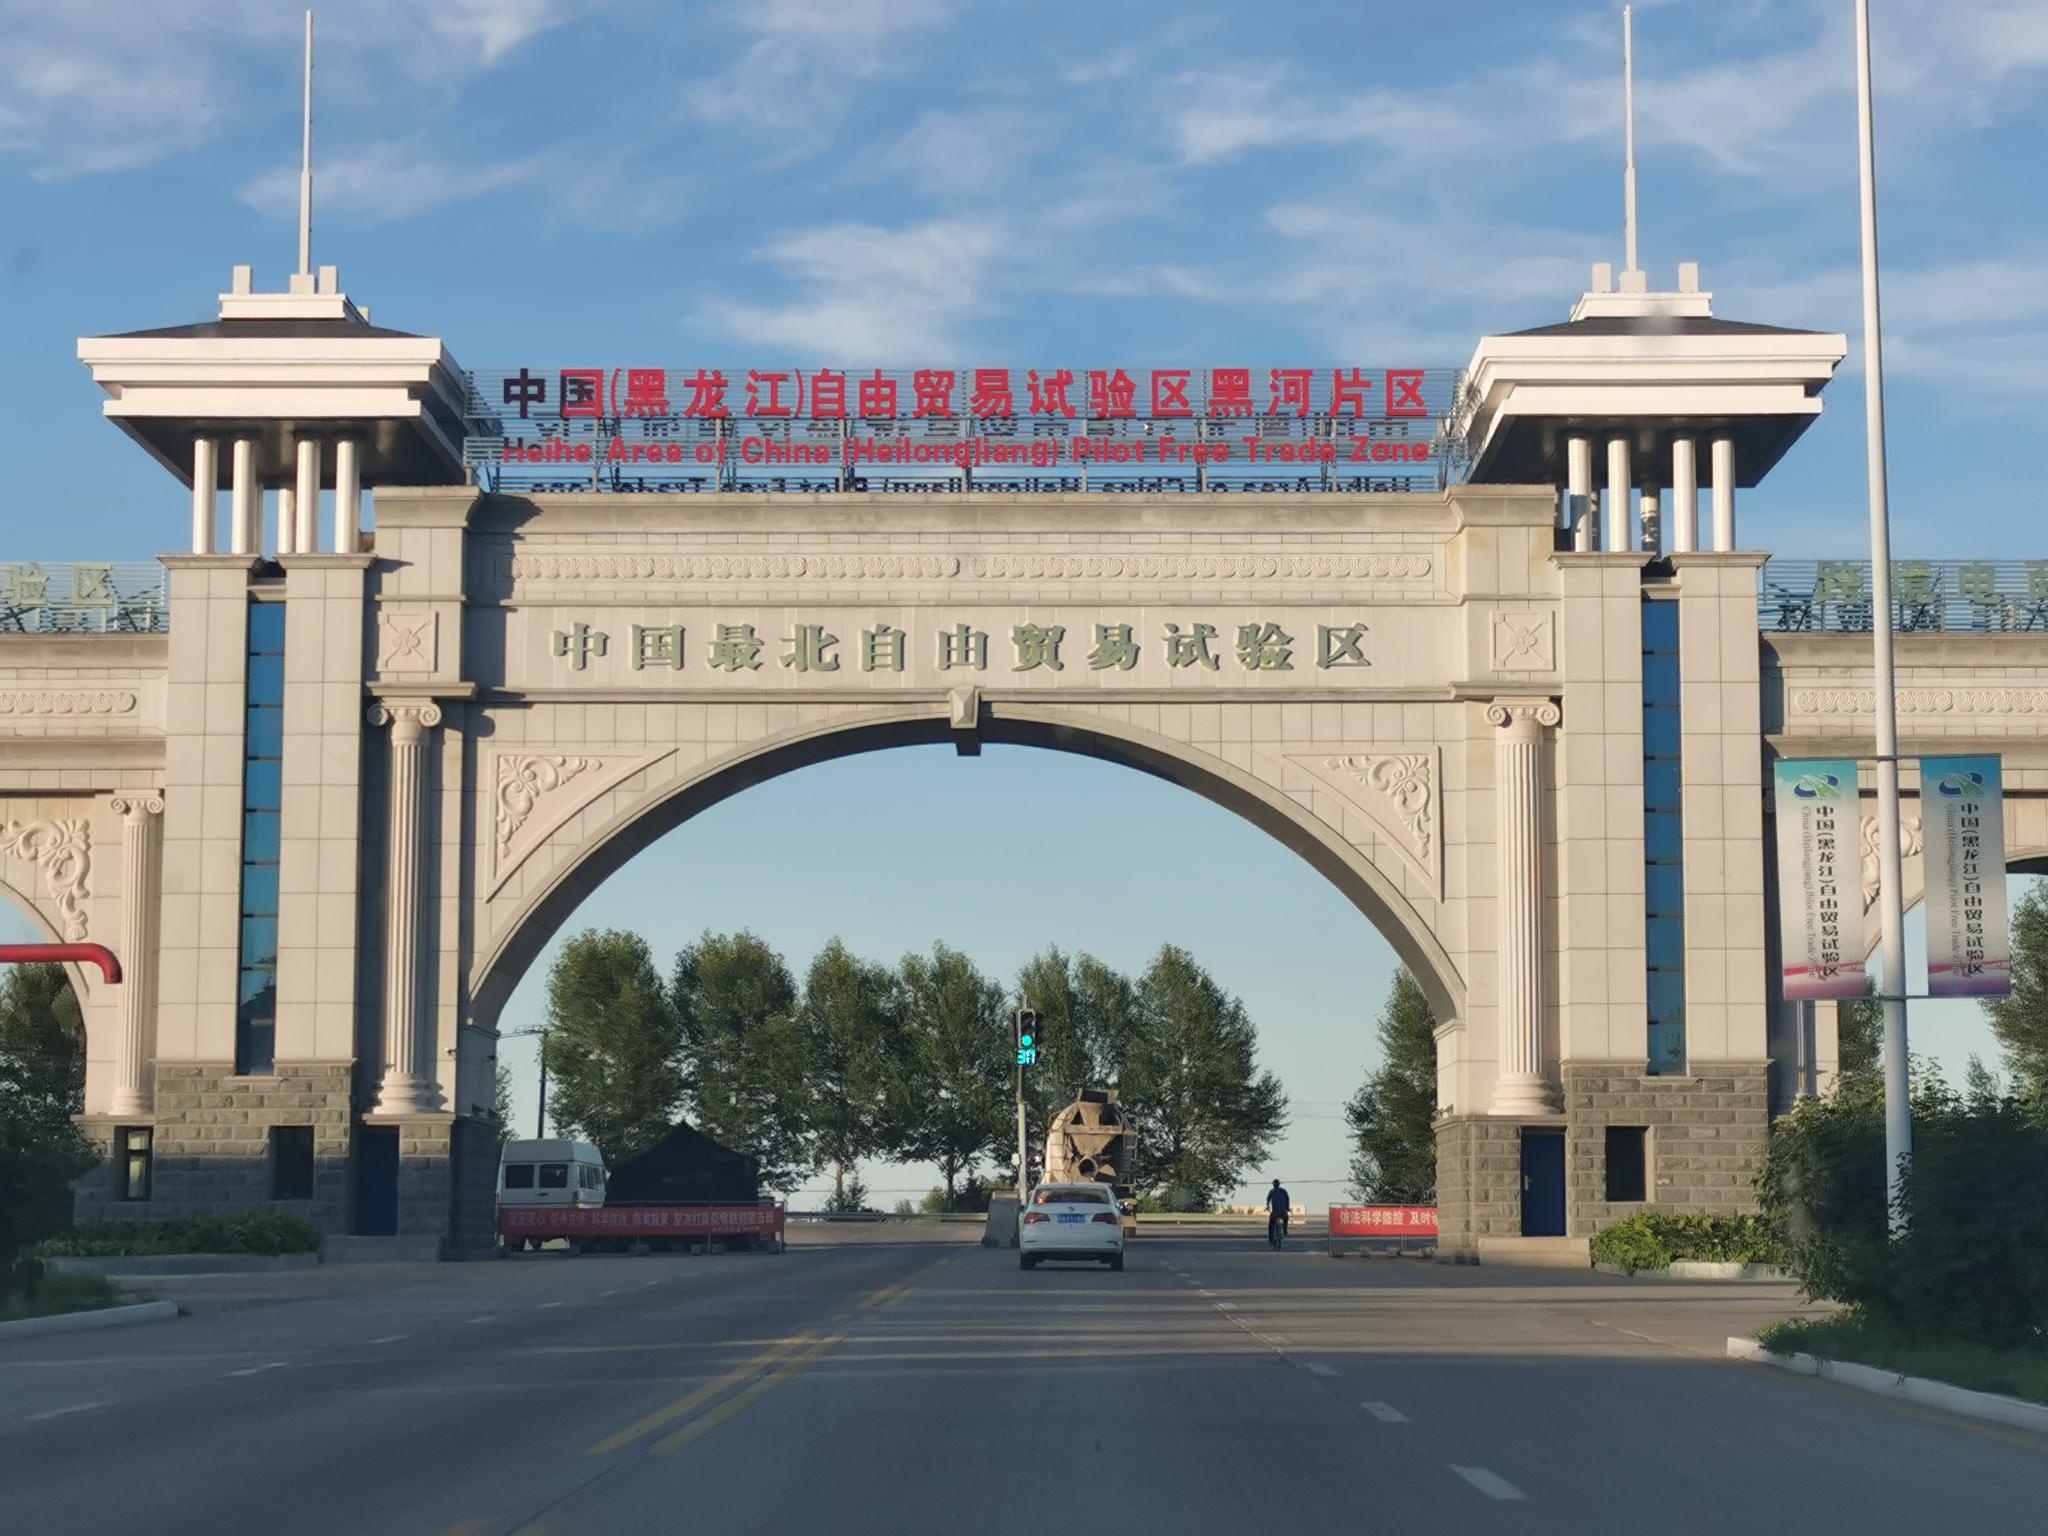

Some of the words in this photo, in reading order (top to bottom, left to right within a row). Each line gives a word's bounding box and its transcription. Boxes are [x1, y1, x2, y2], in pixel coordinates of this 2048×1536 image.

[503, 368, 1428, 420] 中国(黑龙江)自由贸易试验区黑河片区
[502, 436, 592, 463] Heihe
[606, 436, 682, 463] Area
[695, 436, 728, 464] of
[741, 437, 830, 464] China
[1072, 437, 1144, 463] Pilot
[1158, 437, 1230, 463] Free
[1243, 436, 1336, 463] Trade
[1350, 436, 1429, 463] Zone
[553, 623, 1372, 672] 中国最北自由贸易试验区
[1816, 806, 1840, 977] 中国(黑龙江)自由贸易试验区
[1961, 803, 1984, 974] 中国(黑龙江)自由贸易试验区
